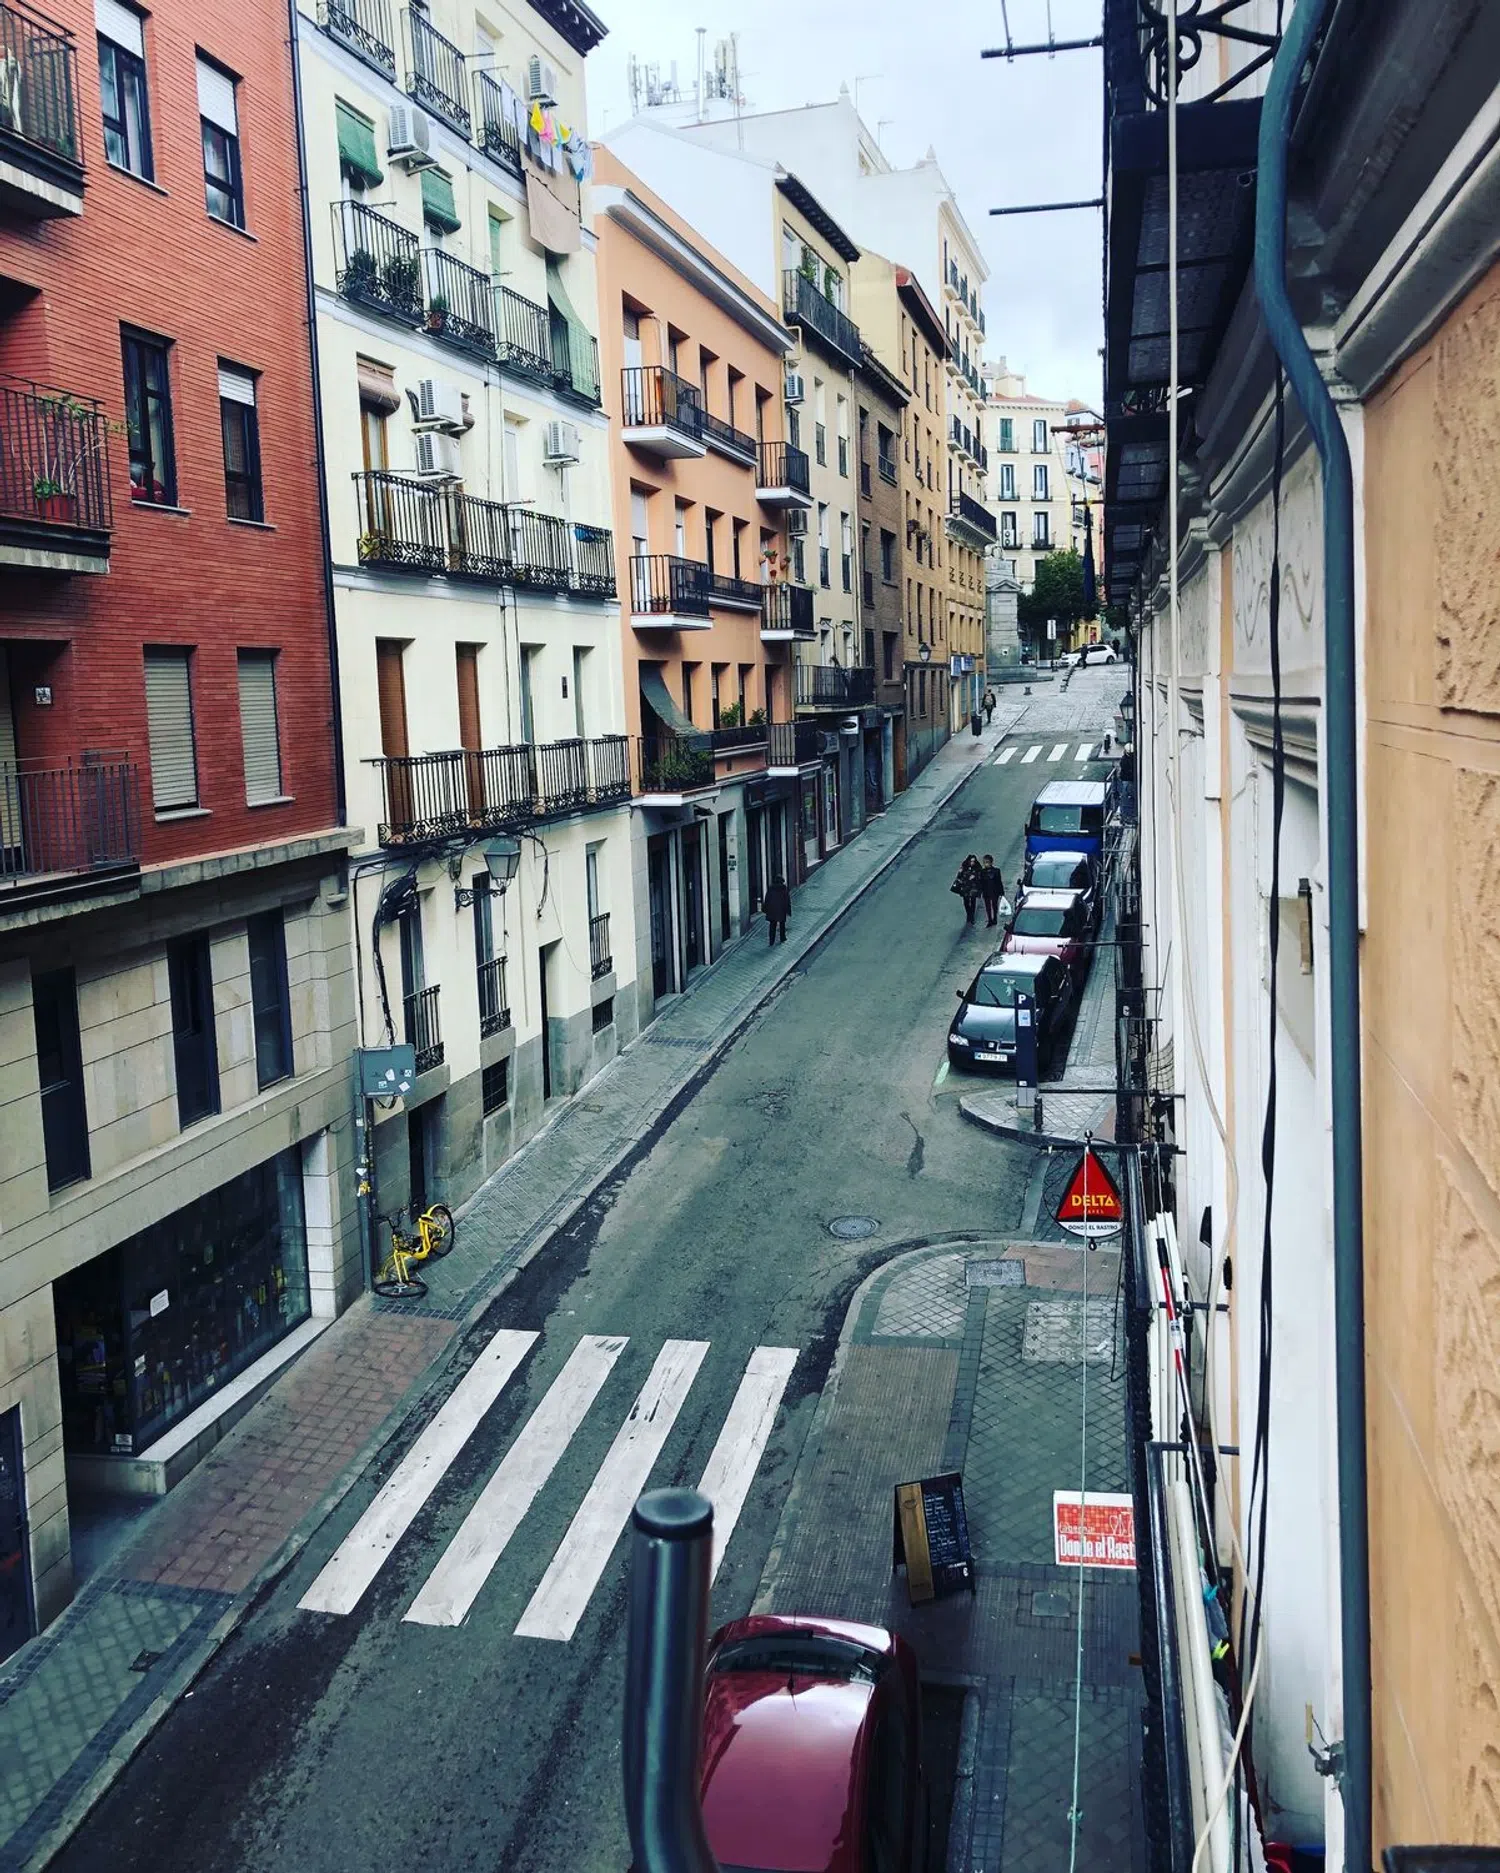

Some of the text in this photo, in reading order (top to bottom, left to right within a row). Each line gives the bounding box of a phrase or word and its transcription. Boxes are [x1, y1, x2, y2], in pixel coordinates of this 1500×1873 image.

[1018, 994, 1026, 1004] P
[1071, 1194, 1115, 1207] DELTA
[1095, 1535, 1105, 1558] el
